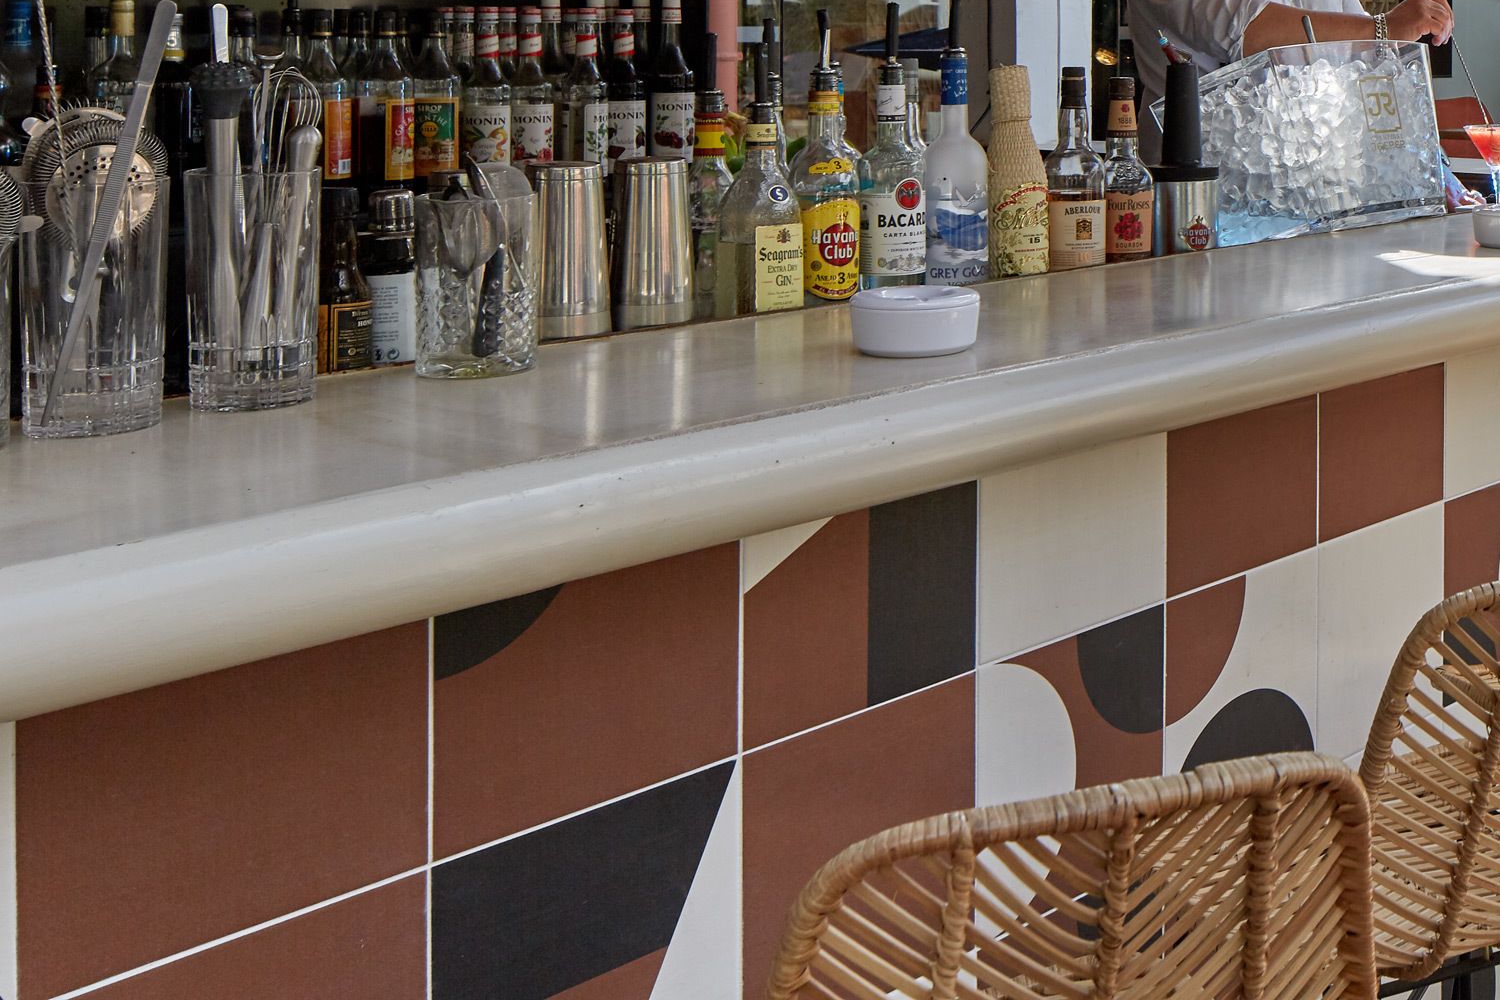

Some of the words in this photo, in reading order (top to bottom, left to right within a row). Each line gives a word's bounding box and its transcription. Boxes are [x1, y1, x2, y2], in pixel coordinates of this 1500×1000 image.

[656, 103, 694, 111] MONIN
[513, 115, 552, 123] MONIN
[608, 111, 645, 120] MONIN
[466, 116, 506, 126] MONIN
[833, 161, 842, 170] 3
[1107, 199, 1126, 211] Four
[1127, 199, 1150, 210] Roses
[1064, 206, 1101, 216] ABERLOUR
[878, 211, 925, 228] BACARD
[1190, 236, 1207, 245] Club
[759, 245, 804, 263] Seagram's
[824, 244, 853, 260] Club
[767, 265, 786, 273] EXTRA
[930, 267, 959, 279] GREY
[962, 264, 985, 278] GOO
[838, 272, 845, 284] 3
